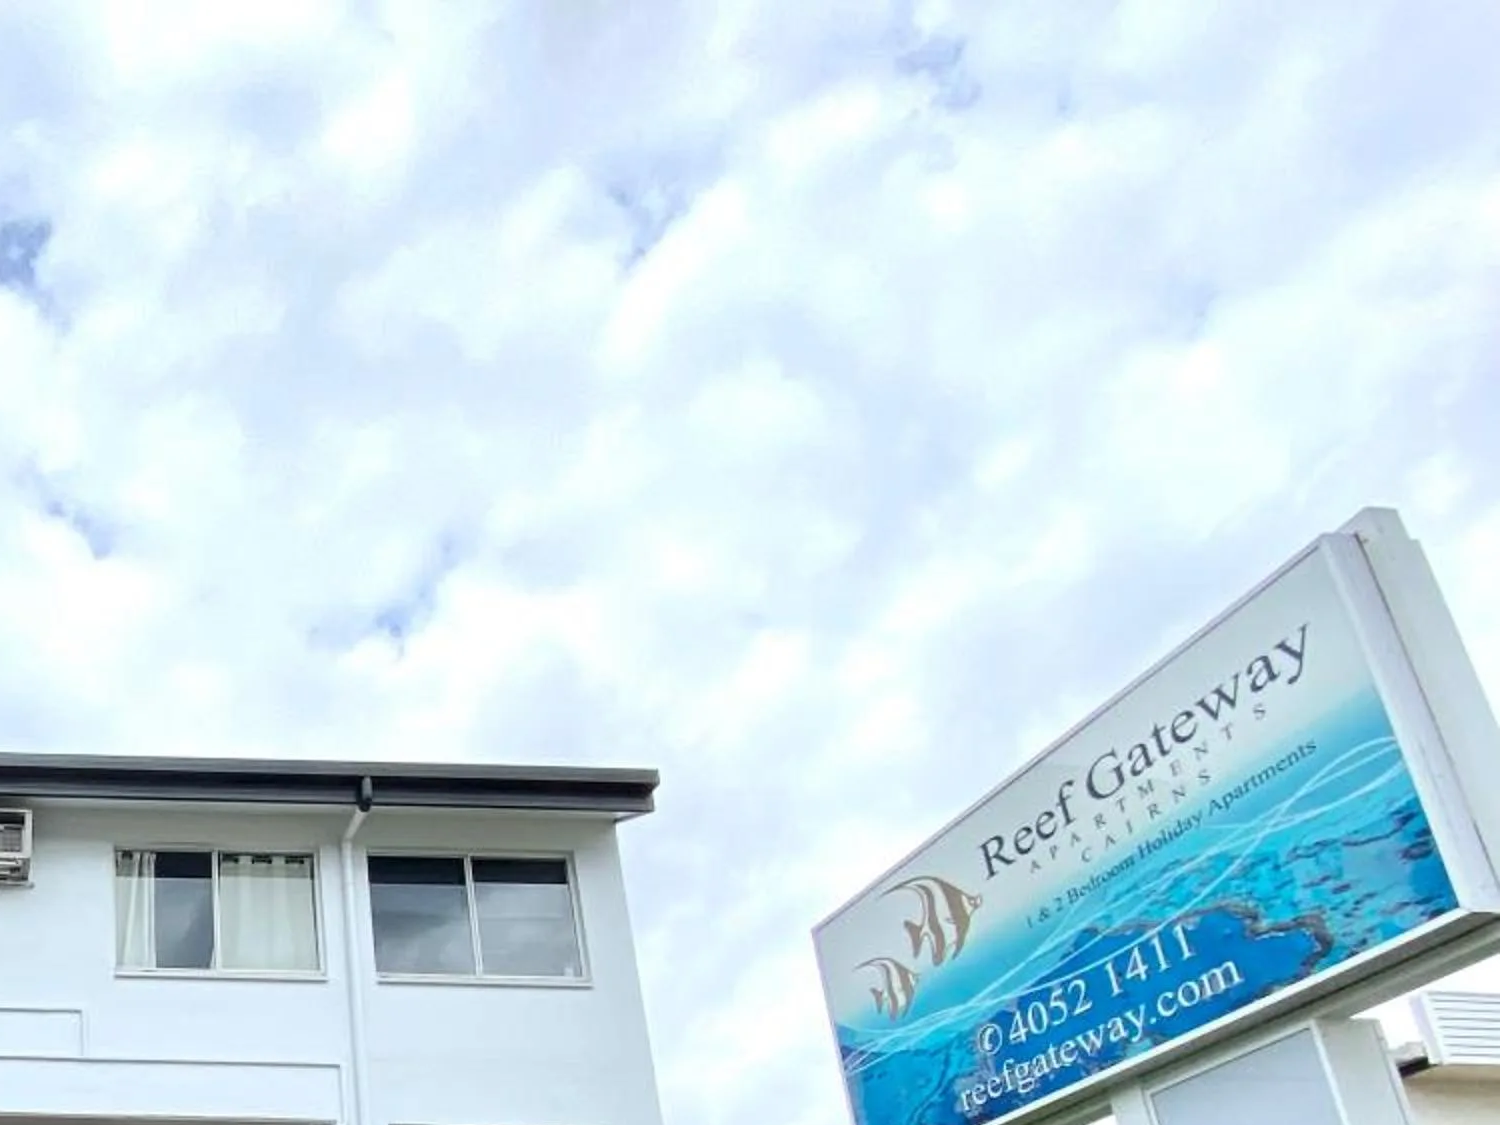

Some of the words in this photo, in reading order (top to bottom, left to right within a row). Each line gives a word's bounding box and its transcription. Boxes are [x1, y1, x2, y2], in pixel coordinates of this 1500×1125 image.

[978, 779, 1075, 880] Reef
[1086, 623, 1310, 800] Gateway
[1030, 702, 1267, 873] APARTMENTS
[1055, 897, 1065, 912] 2
[1066, 855, 1136, 906] Bedroom
[1136, 812, 1203, 860] Holiday
[1208, 739, 1317, 817] Apartments
[1082, 769, 1211, 863] CAIRNS
[960, 959, 1245, 1111] reefgateway.com
[1009, 979, 1093, 1045] 4052
[1105, 922, 1197, 997] 1411
